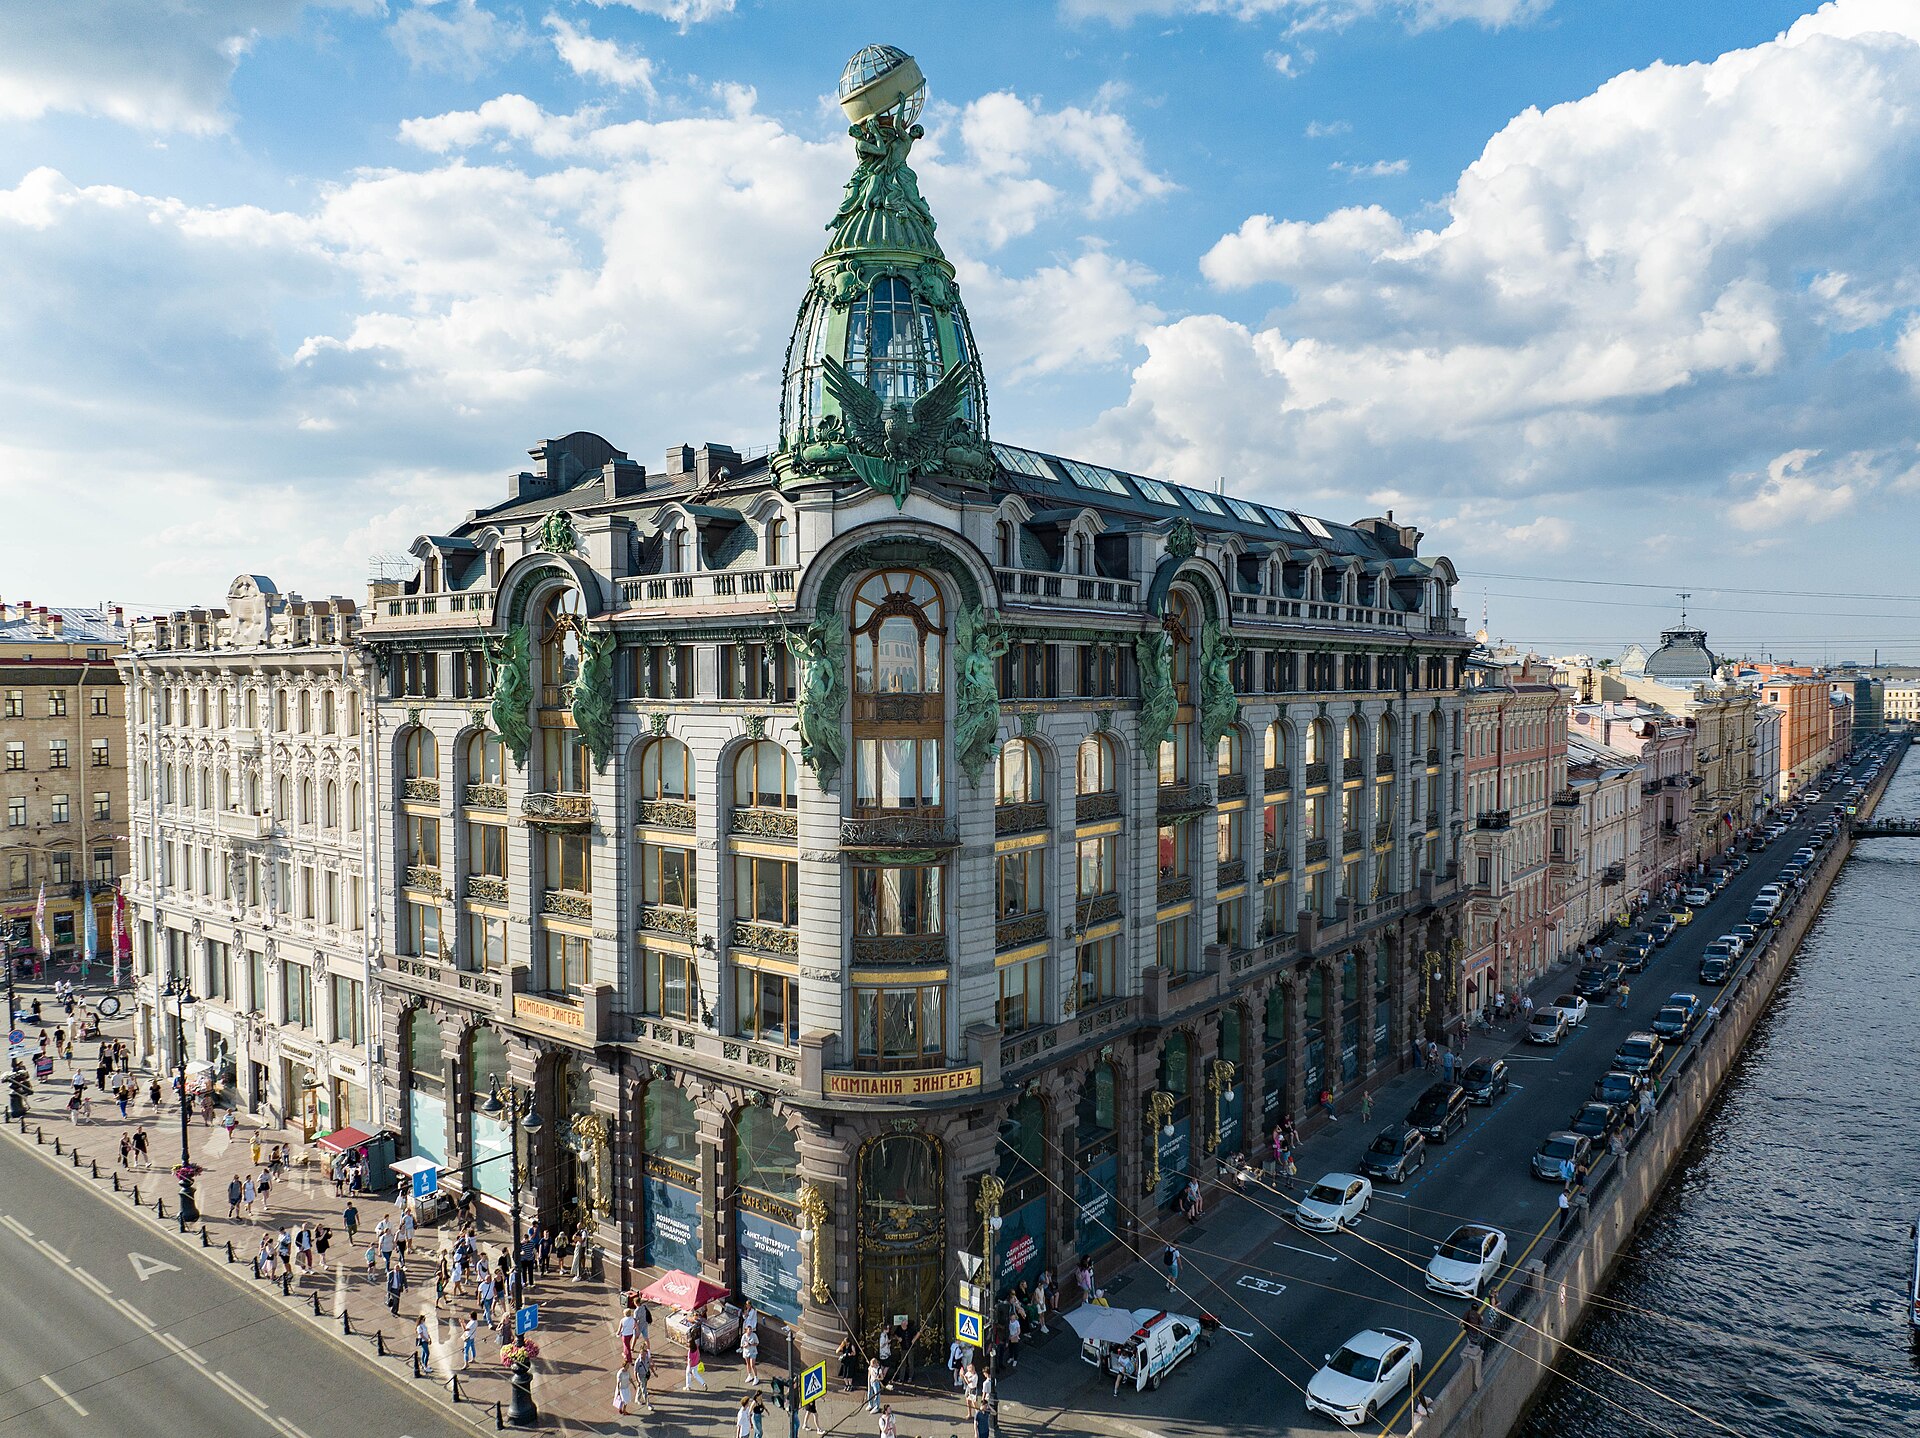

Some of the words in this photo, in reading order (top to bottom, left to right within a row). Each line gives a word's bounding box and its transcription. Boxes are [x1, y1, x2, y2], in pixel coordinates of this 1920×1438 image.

[518, 999, 550, 1018] КОМПАНІЯ
[831, 1076, 903, 1094] КОМПАНІЯ
[913, 1071, 973, 1093] ЗИНГЕРЪ
[743, 1229, 791, 1251] САНКТ-ПЕТЕРБУРГ
[754, 1241, 766, 1250] ЭТО
[766, 1245, 784, 1257] КНИГИ
